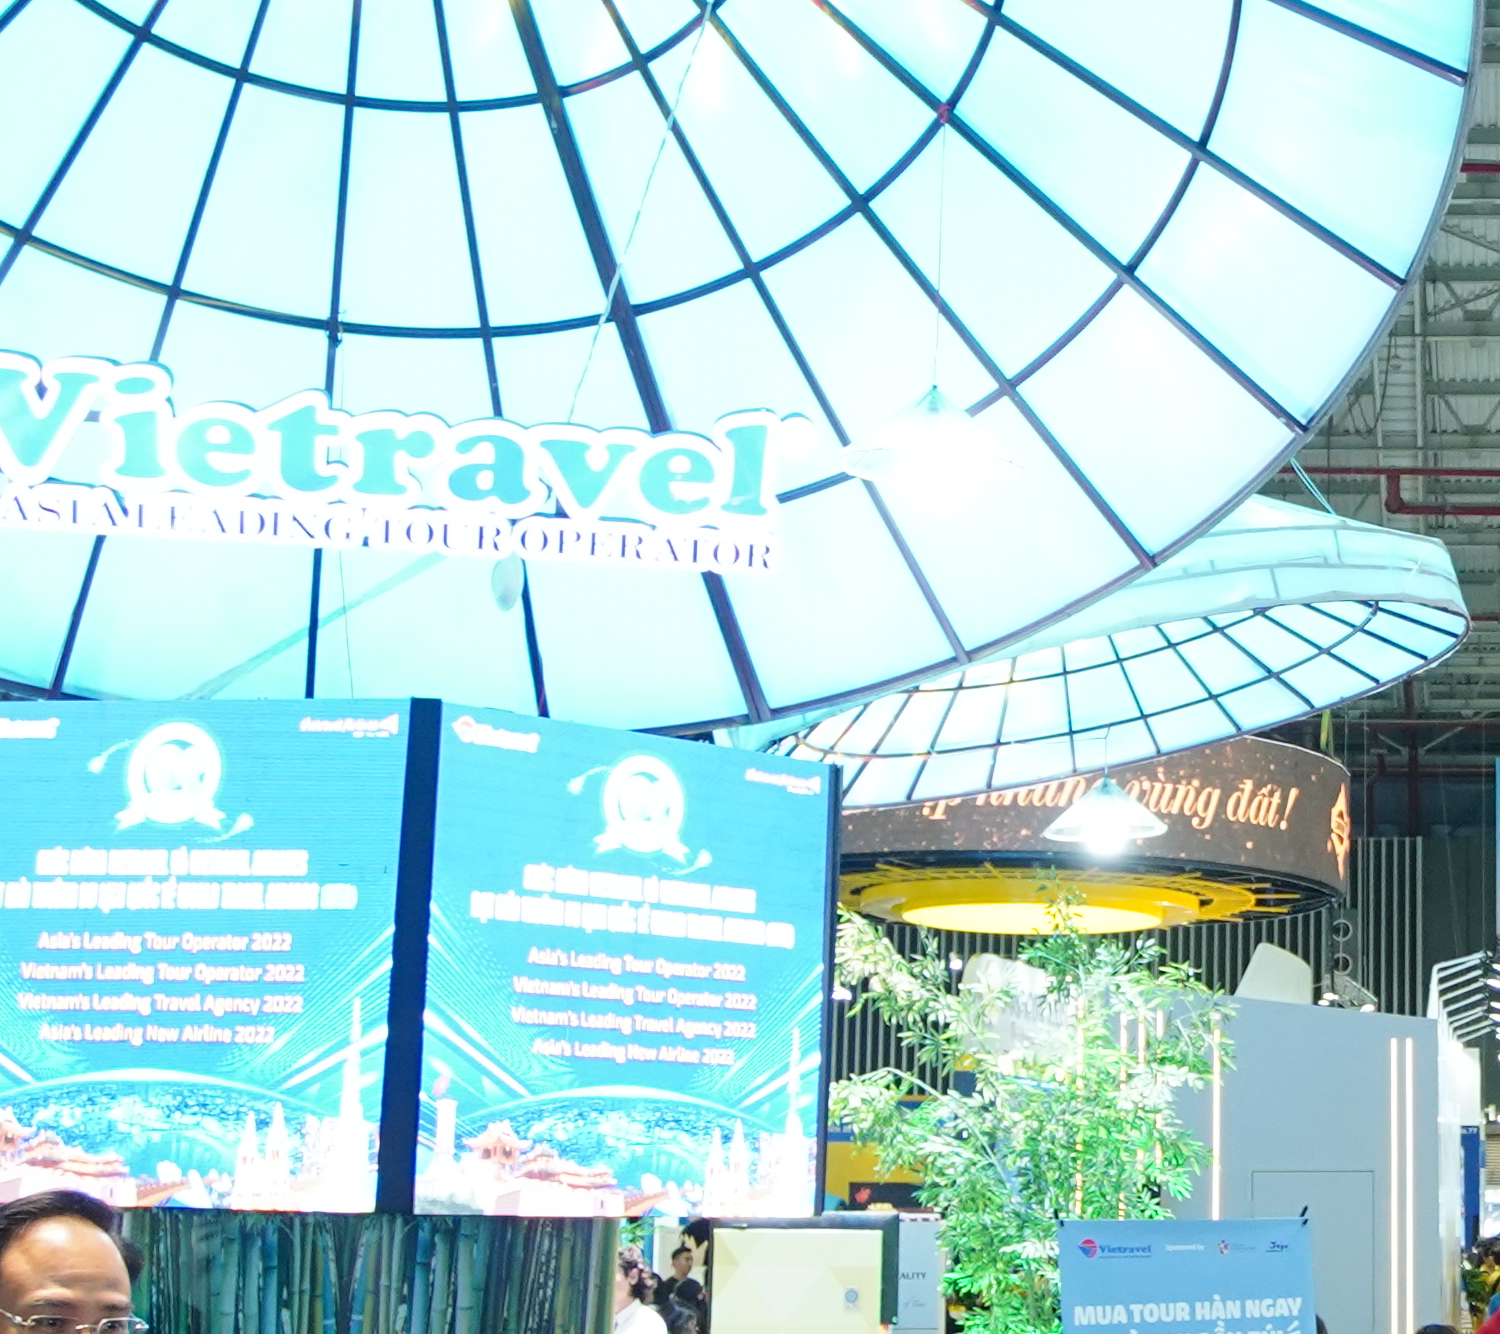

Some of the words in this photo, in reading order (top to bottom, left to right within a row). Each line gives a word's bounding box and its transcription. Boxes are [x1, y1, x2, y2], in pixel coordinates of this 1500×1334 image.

[134, 498, 354, 544] LEADING
[380, 515, 504, 554] TOUR
[519, 527, 773, 571] OPERATOR
[1225, 778, 1300, 832] đất!
[38, 931, 81, 950] Asia's
[83, 931, 142, 954] Leading
[144, 932, 180, 950] Tour
[181, 932, 249, 953] Operator
[251, 932, 292, 951] 2022
[20, 962, 93, 980] Vietnam's
[96, 962, 154, 985] Leading
[157, 963, 192, 981] Tour
[194, 963, 262, 985] Operator
[264, 963, 305, 983] 2022
[18, 993, 90, 1010] Vietnam's
[92, 993, 151, 1016] Leading
[152, 993, 201, 1013] Travel
[203, 995, 260, 1017] Agency
[262, 995, 303, 1014] 2022
[39, 1023, 82, 1041] Asia's
[85, 1023, 143, 1047] Leading
[146, 1025, 180, 1042] New
[182, 1025, 231, 1043] Airline
[234, 1026, 275, 1044] 2022
[1099, 1243, 1152, 1255] Vietravel
[1073, 1305, 1128, 1327] MUA
[1129, 1301, 1191, 1324] TOUR
[1194, 1293, 1242, 1322] HÀN
[1244, 1296, 1303, 1319] NGAY
